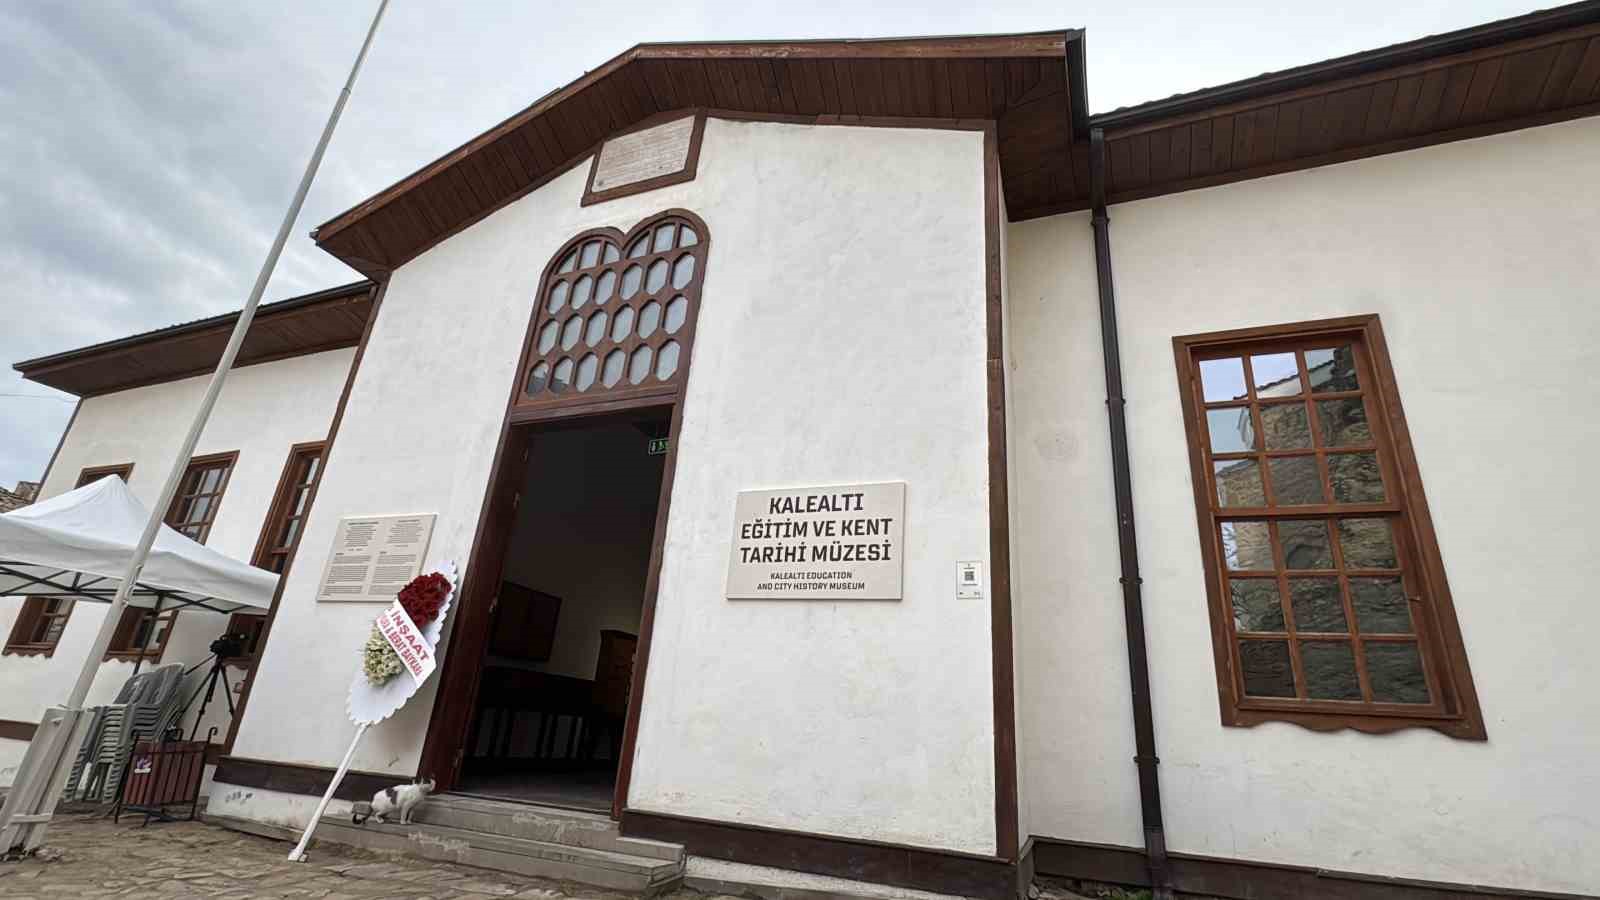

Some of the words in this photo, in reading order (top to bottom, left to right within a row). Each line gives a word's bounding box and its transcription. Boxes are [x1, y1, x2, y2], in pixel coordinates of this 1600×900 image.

[769, 493, 864, 515] KALEALTI
[741, 518, 808, 540] EĞİTİM
[813, 520, 836, 537] VE
[841, 518, 893, 537] KENT
[740, 542, 807, 563] TARİHİ
[812, 540, 892, 562] MÜZESİ
[757, 583, 773, 591] AND
[774, 583, 792, 591] CITY
[793, 582, 828, 590] HISTORY
[829, 582, 865, 590] MUSEUM
[770, 572, 805, 580] KALEALTI
[806, 571, 853, 580] EDUCATION
[391, 610, 429, 661] İNŞAAT
